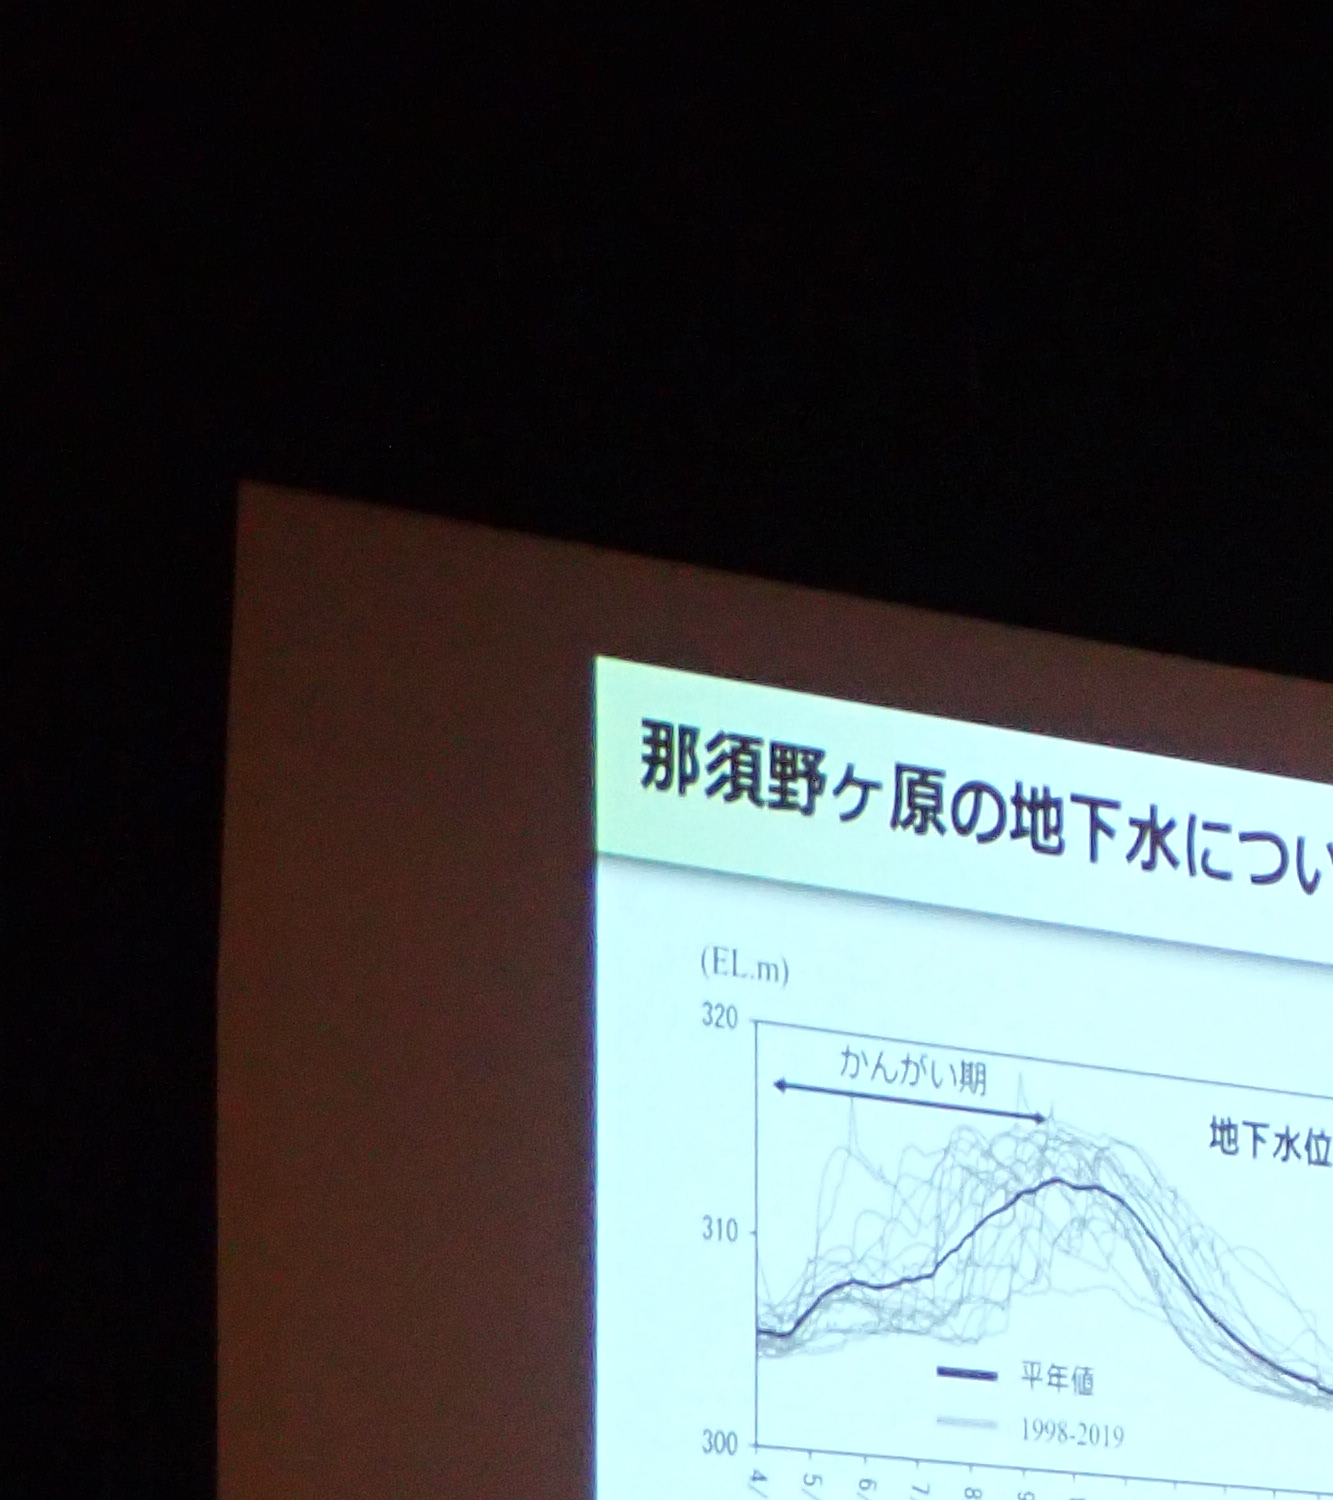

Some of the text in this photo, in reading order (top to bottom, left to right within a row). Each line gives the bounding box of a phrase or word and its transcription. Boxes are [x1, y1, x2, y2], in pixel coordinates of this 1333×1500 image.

[700, 945, 789, 986] (EL.m)
[702, 1000, 738, 1029] 320
[840, 1043, 987, 1097] かんがい期
[1209, 1115, 1333, 1168] 地下水位
[702, 1214, 738, 1243] 310
[1021, 1360, 1094, 1397] 平年値
[702, 1428, 738, 1457] 300
[1022, 1417, 1125, 1449] 1998-2019
